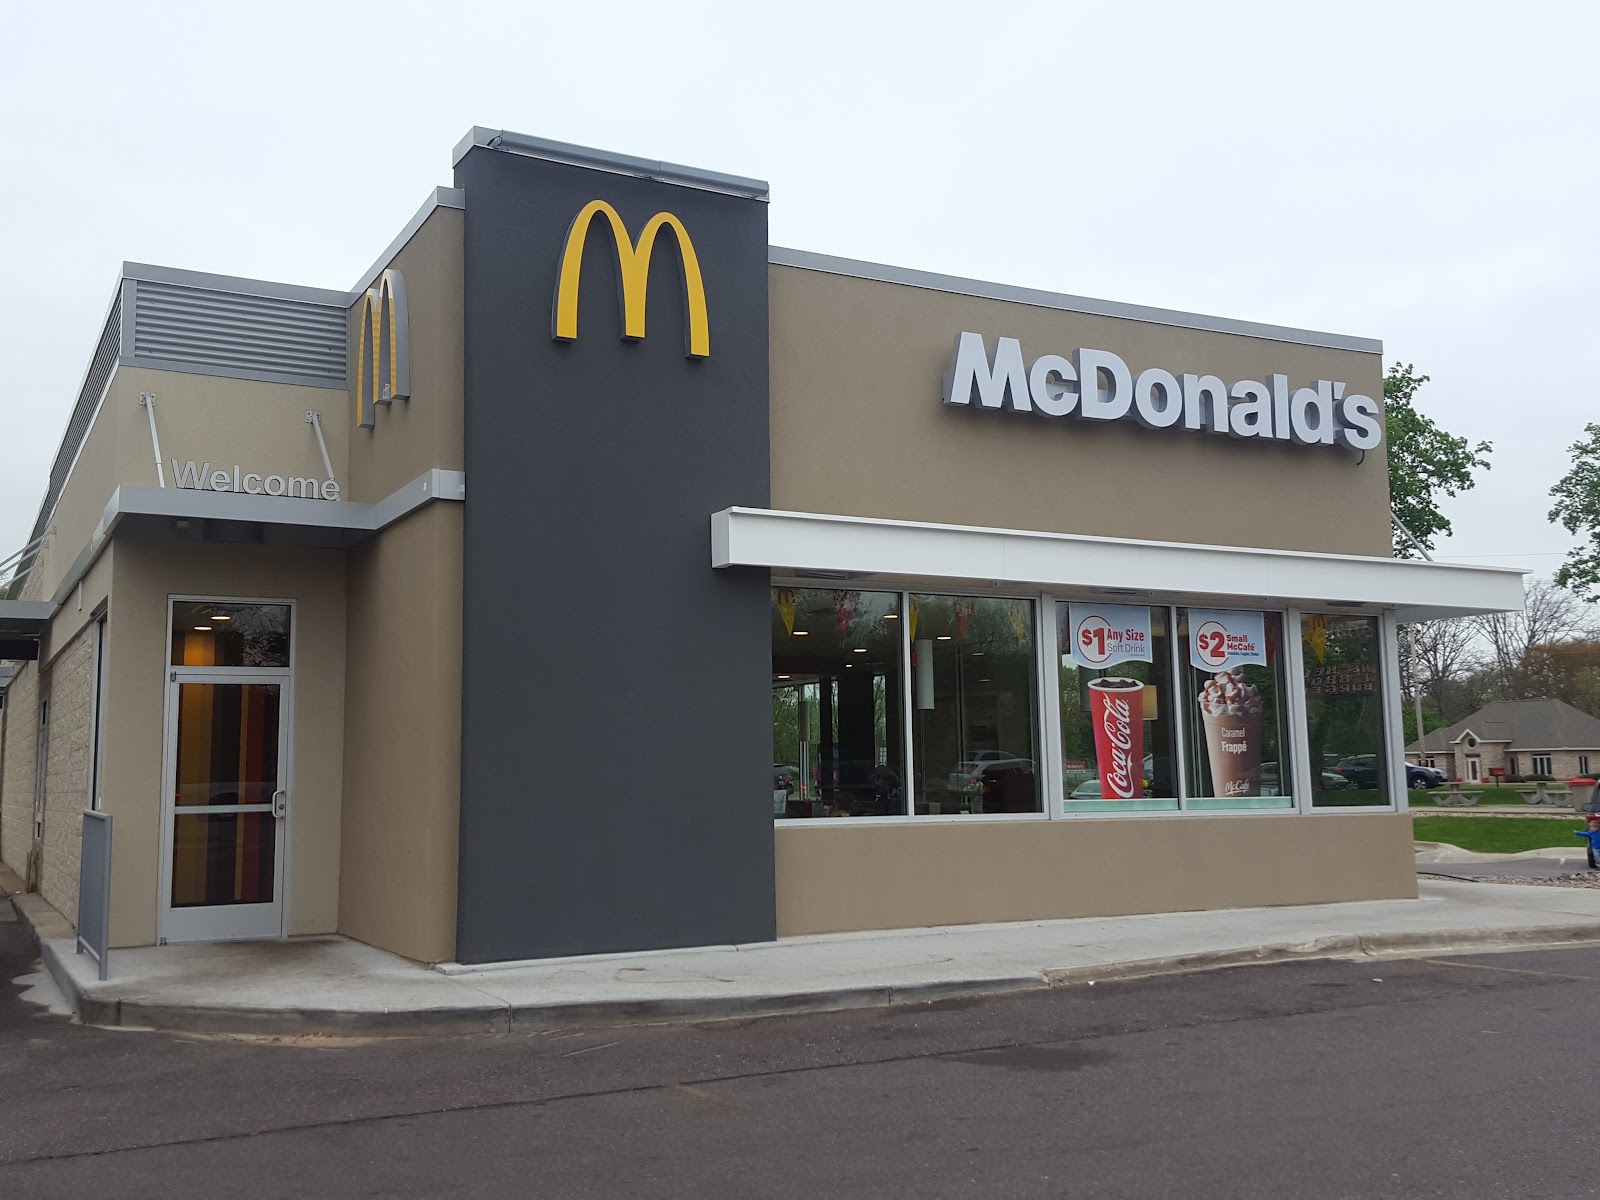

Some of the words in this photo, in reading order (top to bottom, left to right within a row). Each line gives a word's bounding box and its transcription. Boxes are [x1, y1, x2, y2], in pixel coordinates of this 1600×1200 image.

[947, 331, 1382, 450] McDonald's
[171, 459, 340, 501] Welcome
[1081, 627, 1105, 655] $1
[1107, 628, 1123, 642] Any
[1125, 628, 1145, 642] Size
[1198, 631, 1226, 658] $2
[1226, 634, 1248, 643] Small
[1106, 643, 1123, 652] Soft
[1124, 643, 1145, 653] Drink
[1221, 727, 1245, 738] Caramel
[1103, 692, 1134, 798] Coca-Cola
[1221, 741, 1247, 754] Frappé
